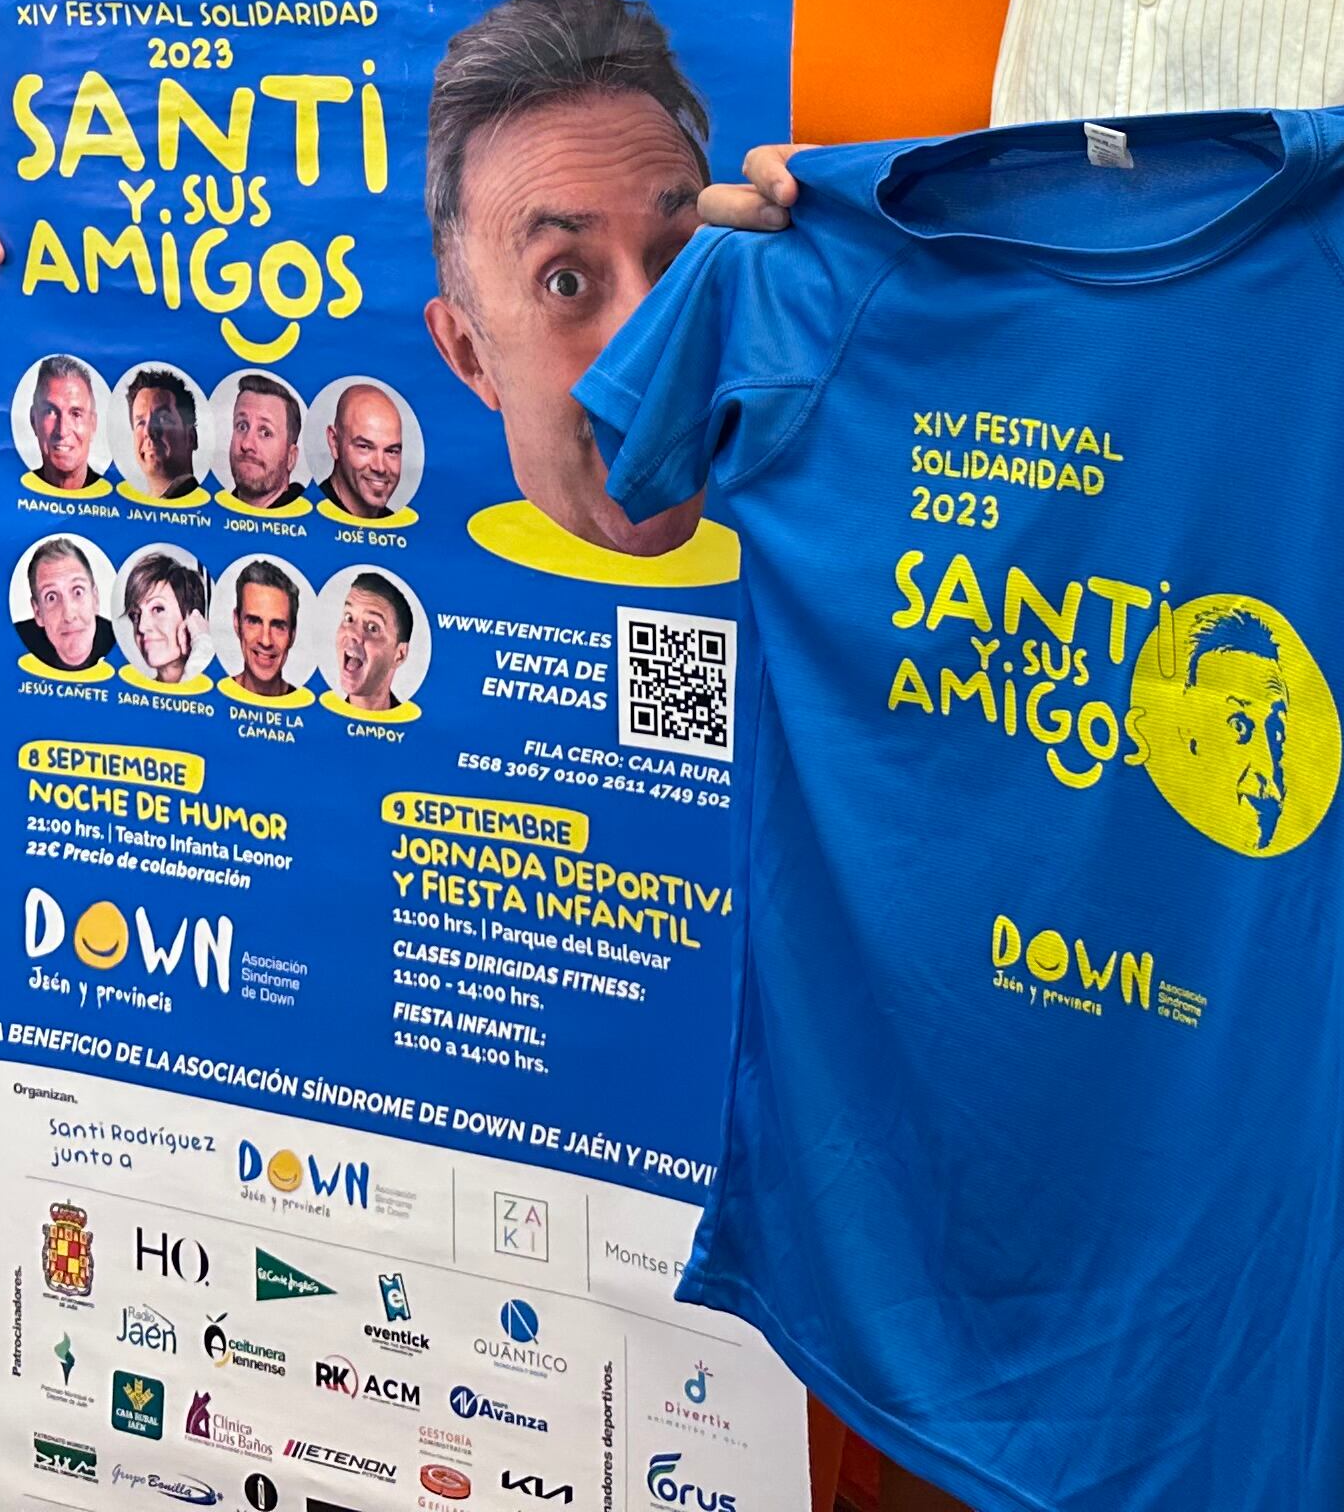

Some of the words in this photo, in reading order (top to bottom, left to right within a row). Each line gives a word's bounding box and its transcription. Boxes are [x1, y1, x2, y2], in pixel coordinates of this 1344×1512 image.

[16, 4, 57, 27] XIV
[66, 2, 193, 26] FESTIVAL
[201, 0, 378, 27] SOLIDARIDAD
[148, 37, 234, 69] 2023
[118, 178, 156, 225] Y
[182, 174, 272, 227] SUS
[913, 411, 967, 437] XIV
[975, 411, 1124, 462] FESTIVAL
[912, 446, 1105, 495] SOLIDARIDAD
[17, 499, 75, 515] MANOLO
[78, 504, 120, 518] SARRIA
[126, 509, 157, 522] JAVI
[160, 510, 211, 527] MARTÍN
[910, 486, 999, 530] 2023
[224, 518, 258, 533] JORDI
[262, 522, 307, 537] MERCA
[334, 526, 364, 544] JOSÉ
[368, 532, 407, 548] BOTO
[437, 613, 612, 649] WWW.EVENTICK.ES
[495, 650, 570, 678] VENTA
[575, 659, 608, 683] DE
[971, 636, 1000, 671] Y
[1023, 639, 1090, 686] SUS
[18, 680, 53, 694] JESÚS
[56, 684, 108, 702] CAÑETE
[118, 692, 149, 706] SARA
[152, 696, 215, 717] ESCUDERO
[482, 677, 608, 711] ENTRADAS
[229, 706, 263, 724] DANI
[266, 711, 282, 725] DE
[286, 715, 304, 728] LA
[238, 722, 295, 743] CÁMARA
[347, 724, 405, 743] CAMPOY
[28, 748, 40, 766] 8
[47, 747, 187, 786] SEPTIEMBRE
[458, 752, 501, 773] ES68
[505, 761, 549, 782] 3067
[554, 768, 599, 788] 0100
[602, 775, 645, 794] 2611
[649, 783, 693, 803] 4749
[697, 791, 731, 809] 502
[523, 739, 564, 762] FILA
[568, 745, 624, 769] CERO:
[628, 755, 676, 776] CAJA
[680, 762, 731, 786] RURA
[28, 779, 129, 817] NOCHE
[136, 789, 171, 823] DE
[179, 798, 288, 841] HUMOR
[393, 801, 406, 820] 9
[414, 799, 572, 846] SEPTIEMBRE
[26, 816, 71, 836] 21:00
[75, 820, 105, 841] hrs.
[115, 825, 167, 850] Teatro
[170, 830, 229, 861] Infanta
[233, 843, 293, 871] Leonor
[391, 833, 547, 881] JORNADA
[26, 841, 60, 858] 22€
[63, 842, 114, 866] Precio
[116, 851, 138, 870] de
[140, 855, 251, 890] colaboración
[392, 870, 415, 897] Y
[422, 868, 527, 913] FIESTA
[536, 890, 701, 949] INFANTIL
[25, 887, 234, 994] DOWN
[392, 908, 440, 930] 11:00
[444, 915, 478, 937] hrs.
[491, 922, 558, 953] Parque
[562, 932, 593, 957] del
[597, 940, 671, 971] Bulevar
[241, 951, 308, 976] Asociación
[393, 940, 461, 968] CLASES
[464, 951, 559, 986] DIRIGIDAS
[562, 968, 646, 1002] FITNESS:
[992, 914, 1154, 1010] DOWN
[28, 966, 71, 995] Jaén
[79, 979, 87, 1008] y
[96, 981, 172, 1014] provincia
[241, 985, 256, 1000] de
[260, 987, 295, 1006] Down
[393, 968, 441, 991] 11:00
[457, 979, 506, 1003] 14:00
[510, 987, 545, 1011] hrs.
[393, 1001, 454, 1030] FIESTA
[457, 1012, 547, 1046] INFANTIL:
[394, 1031, 442, 1054] 11:00
[445, 1041, 457, 1056] a
[460, 1042, 510, 1066] 14:00
[514, 1051, 549, 1074] hrs.
[8, 1023, 112, 1058] BENEFICIO
[115, 1041, 140, 1066] DE
[144, 1049, 170, 1072] LA
[173, 1054, 299, 1096] ASOCIACIÓN
[302, 1077, 415, 1120] SÍNDROME
[418, 1101, 449, 1127] DE
[452, 1108, 526, 1143] DOWN
[529, 1124, 561, 1149] DE
[563, 1132, 622, 1164] JAÉN
[625, 1145, 642, 1166] Y
[644, 1150, 717, 1186] PROVI
[13, 1082, 78, 1104] Organizan.
[49, 1118, 105, 1140] Santi
[111, 1125, 216, 1154] Rodríguez
[51, 1146, 113, 1167] junto
[120, 1152, 132, 1169] a
[239, 1138, 369, 1210] DOWN
[606, 1240, 668, 1275] Montse
[12, 1265, 22, 1377] Patrocinadores.
[116, 1308, 177, 1355] Jaén
[364, 1323, 430, 1351] eventick
[363, 1375, 421, 1406] ACM
[601, 1361, 615, 1447] deportivos.
[213, 1414, 252, 1436] Clínica
[478, 1399, 548, 1432] Avanza
[665, 1401, 730, 1430] Divertix
[212, 1428, 236, 1447] Luis
[238, 1436, 273, 1456] Baños
[419, 1426, 472, 1447] GESTORÍA
[305, 1444, 397, 1478] ETENON
